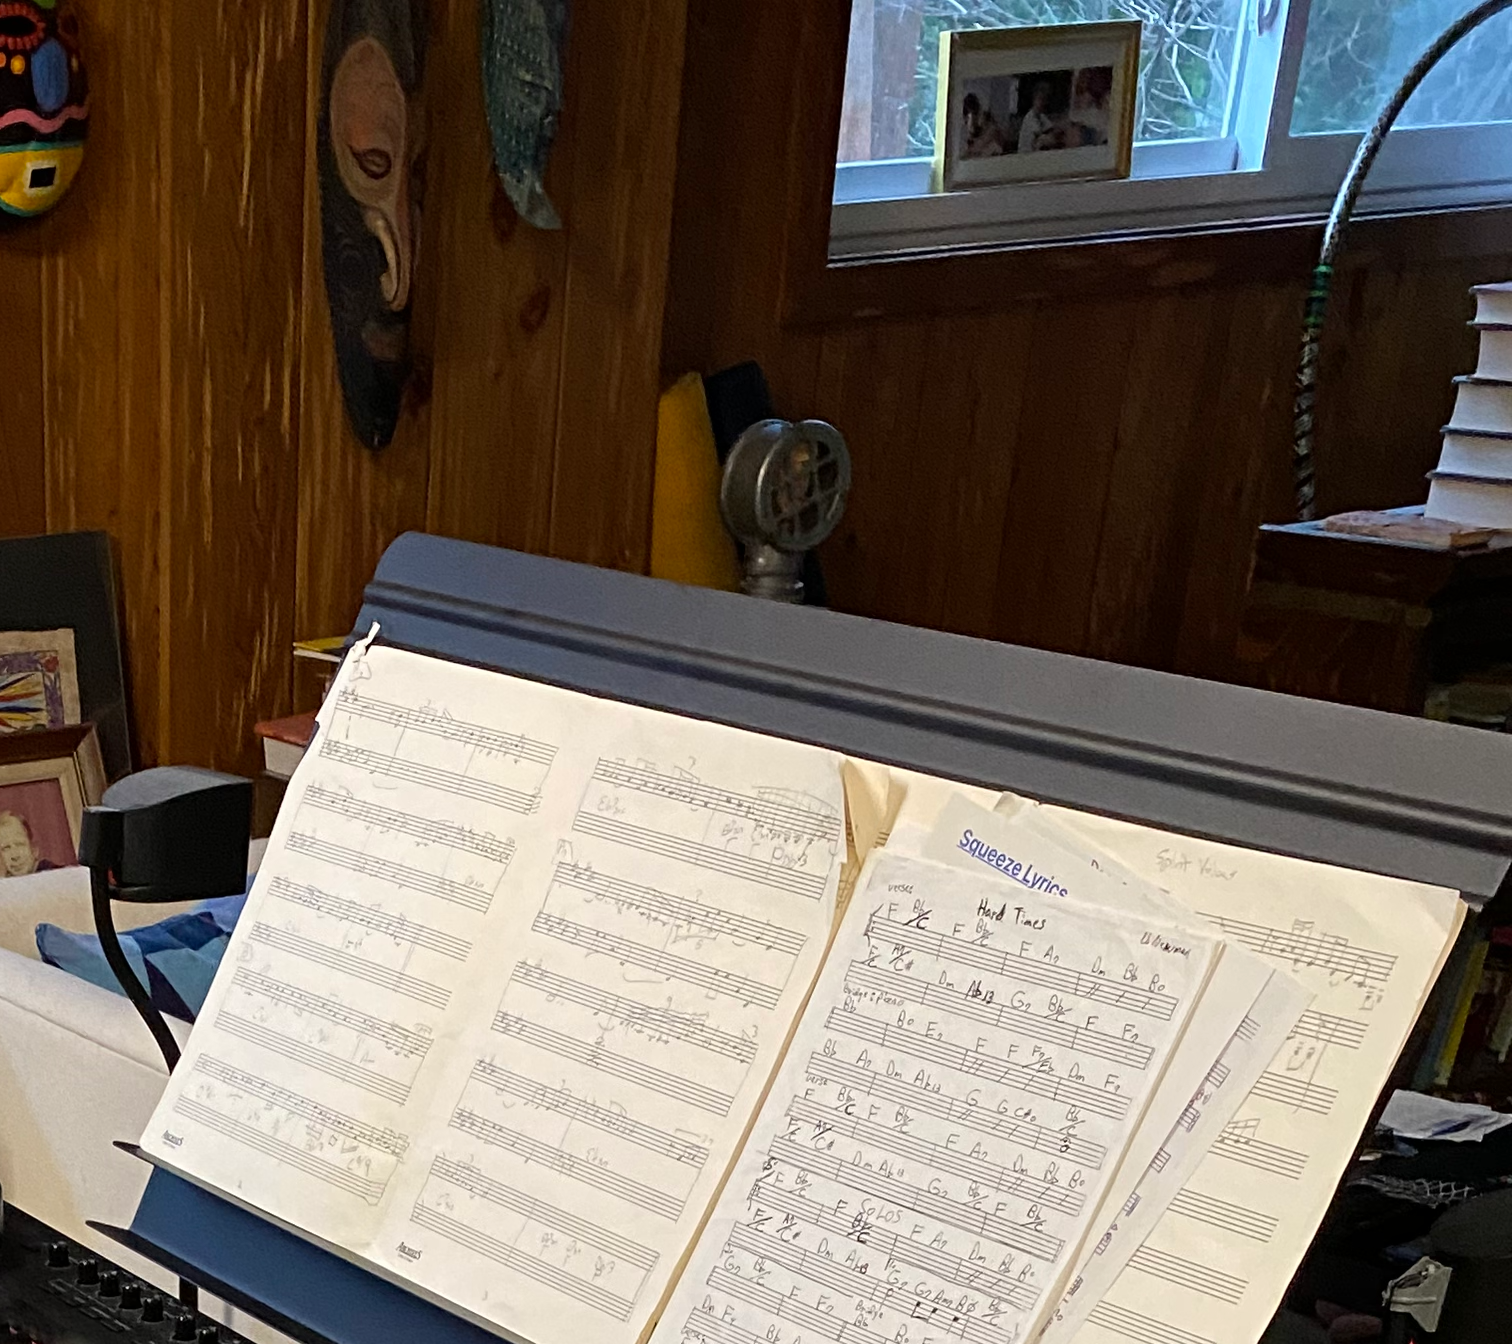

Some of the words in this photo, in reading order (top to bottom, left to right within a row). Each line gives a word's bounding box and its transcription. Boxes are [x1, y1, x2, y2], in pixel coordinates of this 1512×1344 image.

[959, 828, 1023, 877] Squeeze
[976, 897, 1008, 922] Hard
[1014, 906, 1048, 931] Times
